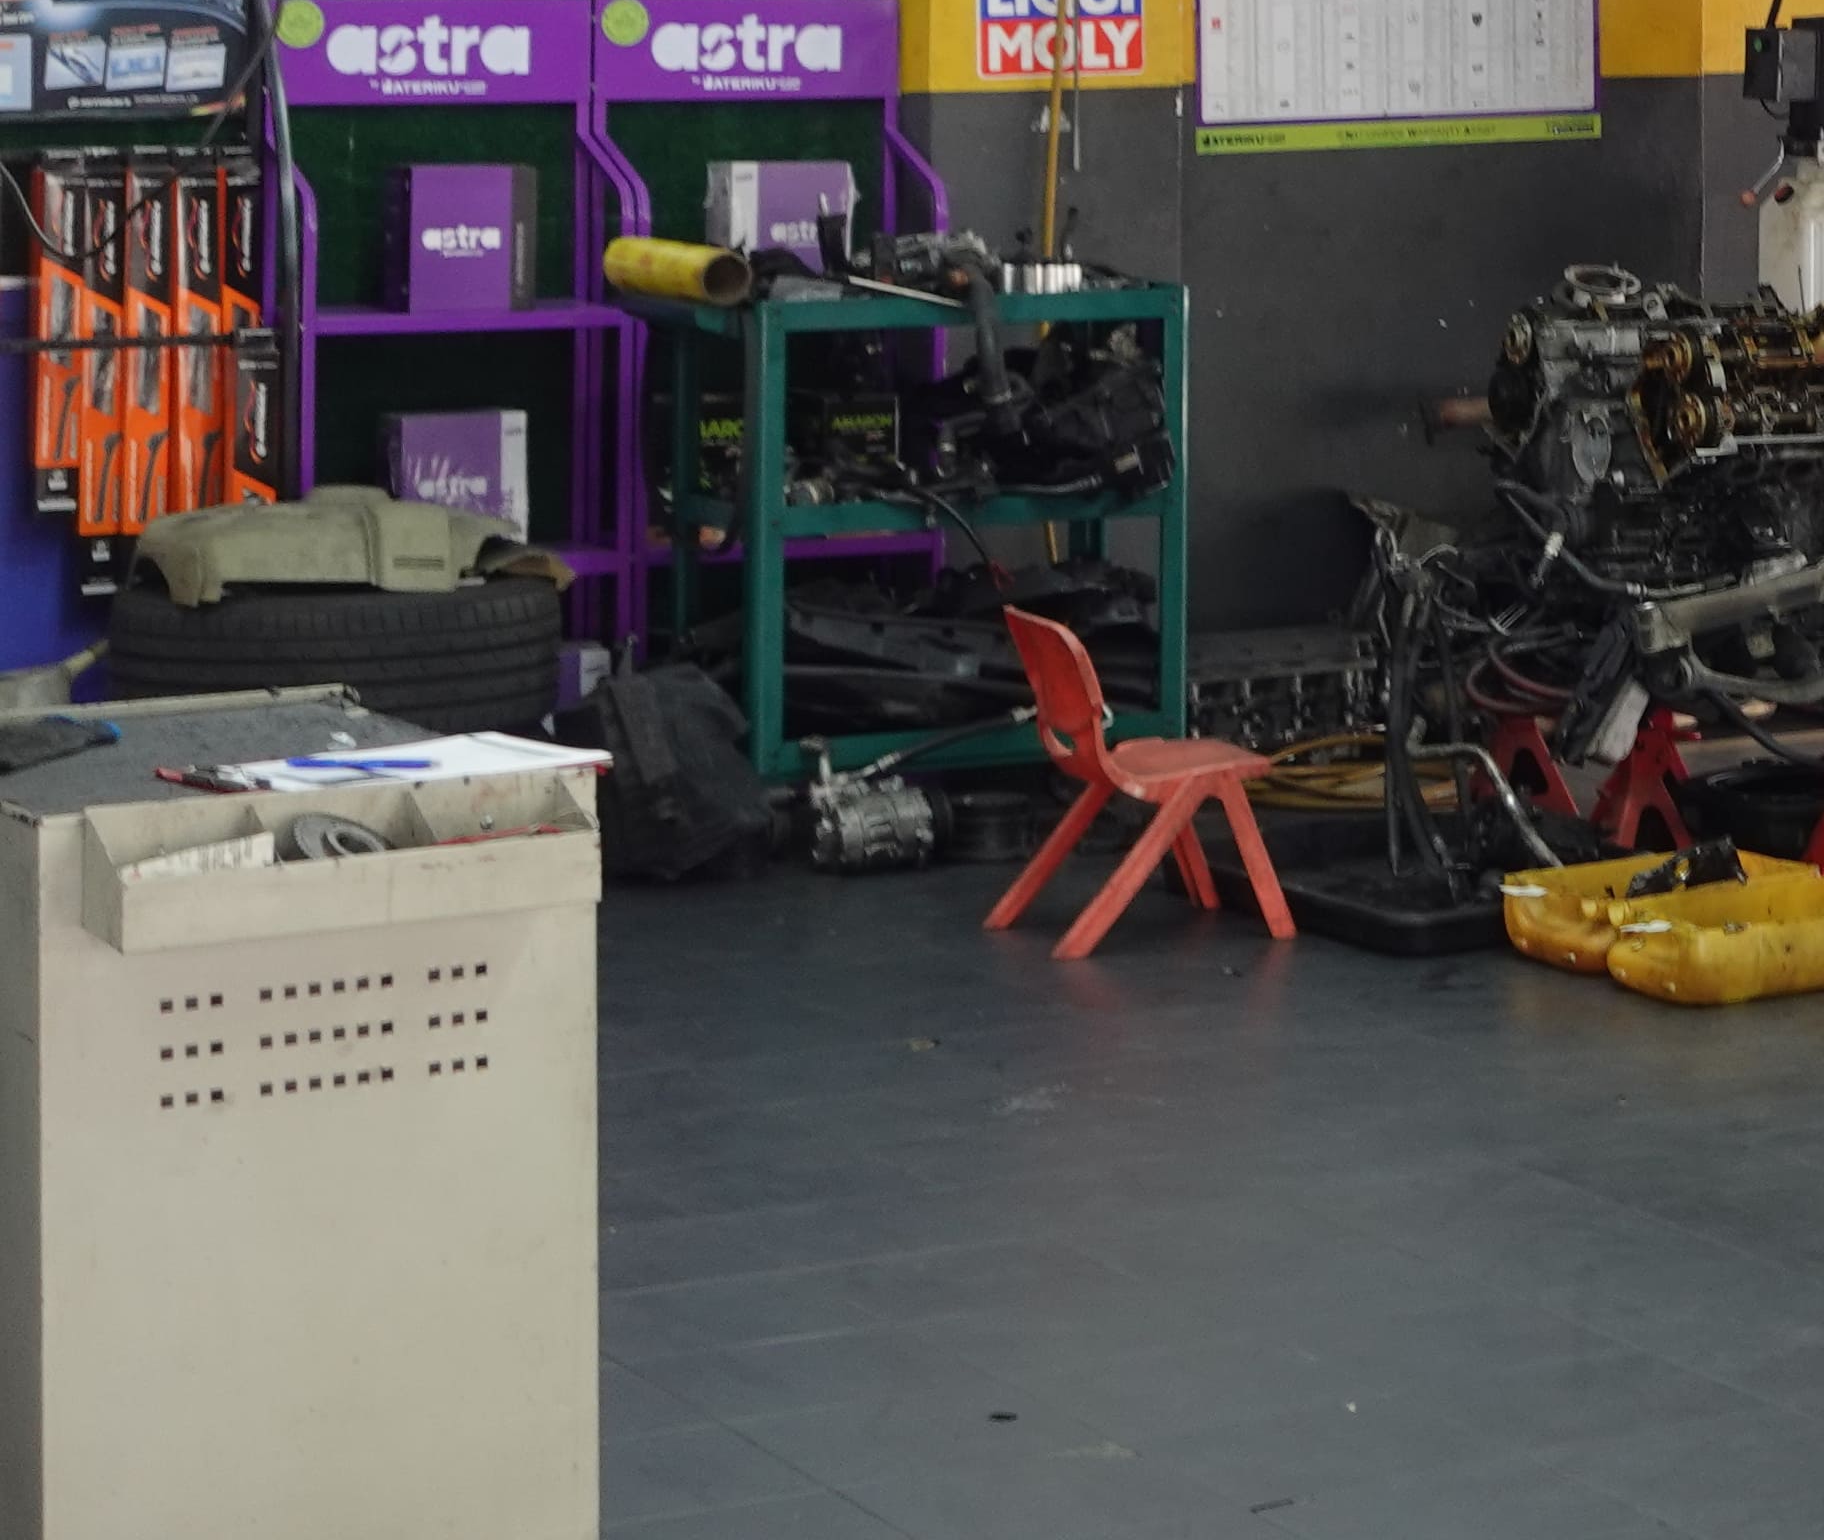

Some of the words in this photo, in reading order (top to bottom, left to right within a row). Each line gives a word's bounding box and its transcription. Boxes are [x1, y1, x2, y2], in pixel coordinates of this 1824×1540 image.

[326, 14, 530, 75] astra
[651, 13, 842, 72] astra
[988, 20, 1139, 72] MOLY
[422, 223, 501, 251] astra
[770, 221, 818, 243] astr
